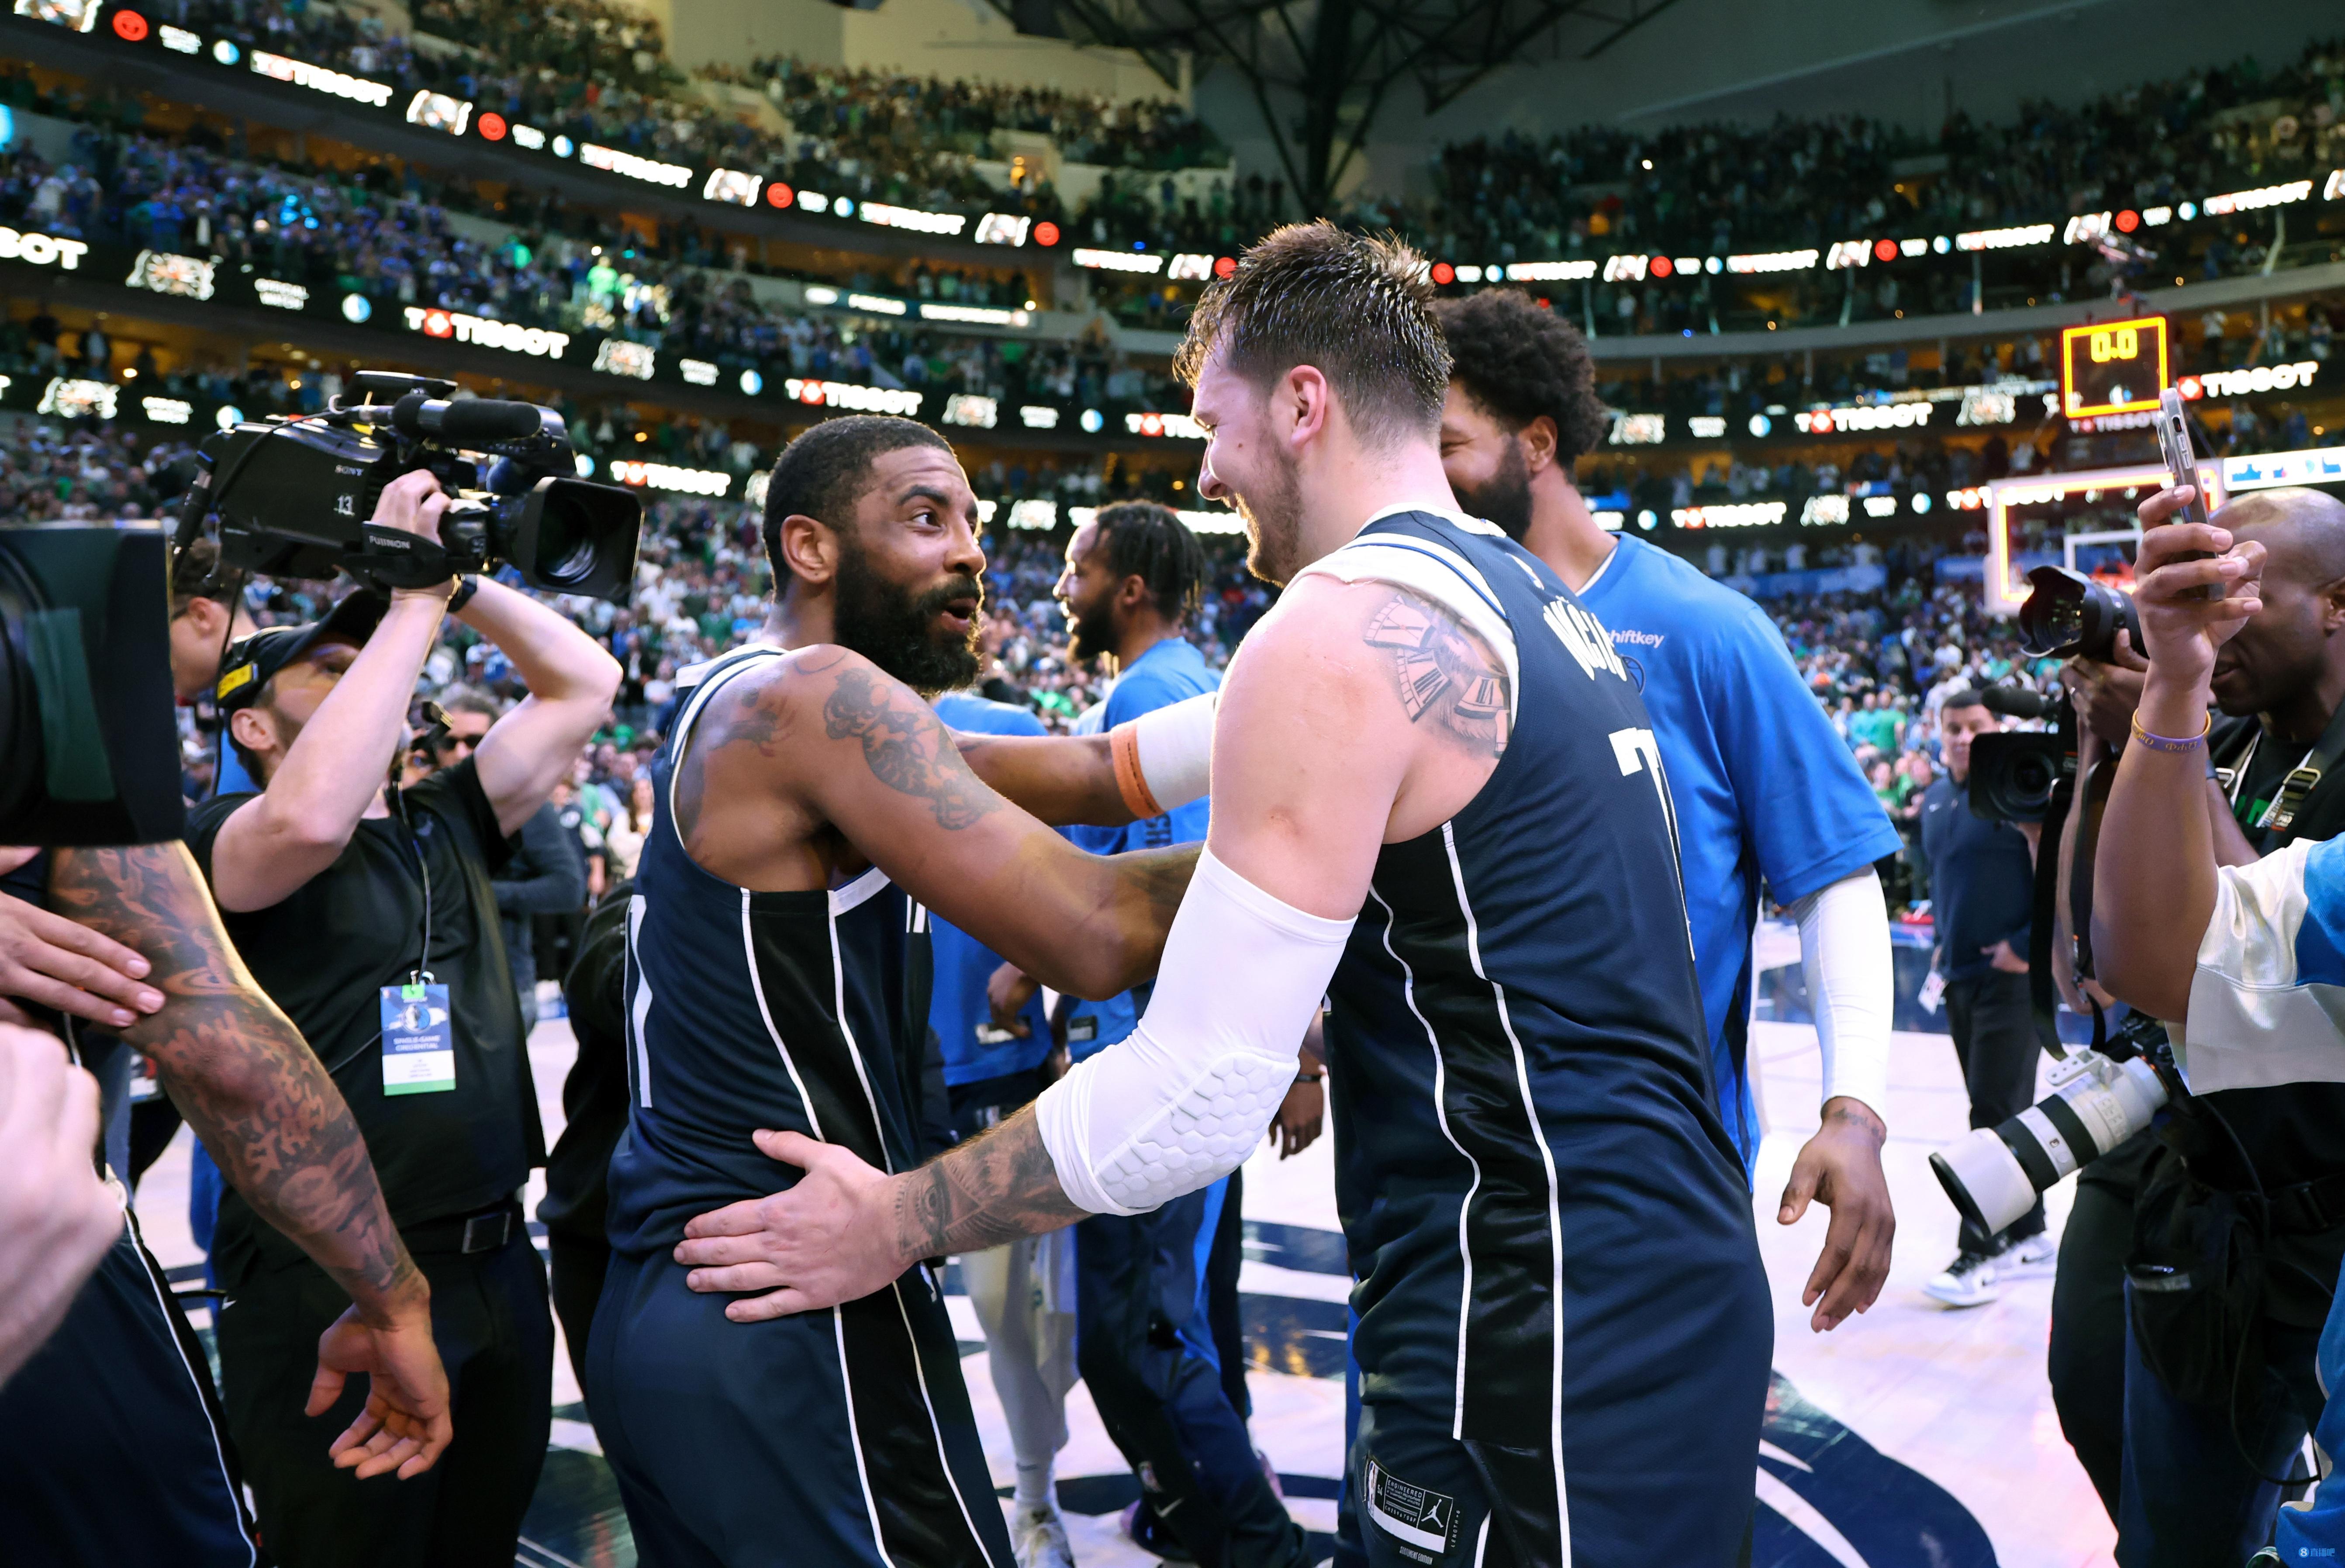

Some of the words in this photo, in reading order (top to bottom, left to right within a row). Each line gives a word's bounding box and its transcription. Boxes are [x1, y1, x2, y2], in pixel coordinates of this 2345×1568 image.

[2090, 328, 2138, 363] 0.0
[335, 465, 364, 476] SONY
[369, 535, 411, 549] FUJINON
[1387, 1479, 1423, 1499] ENGINEERED
